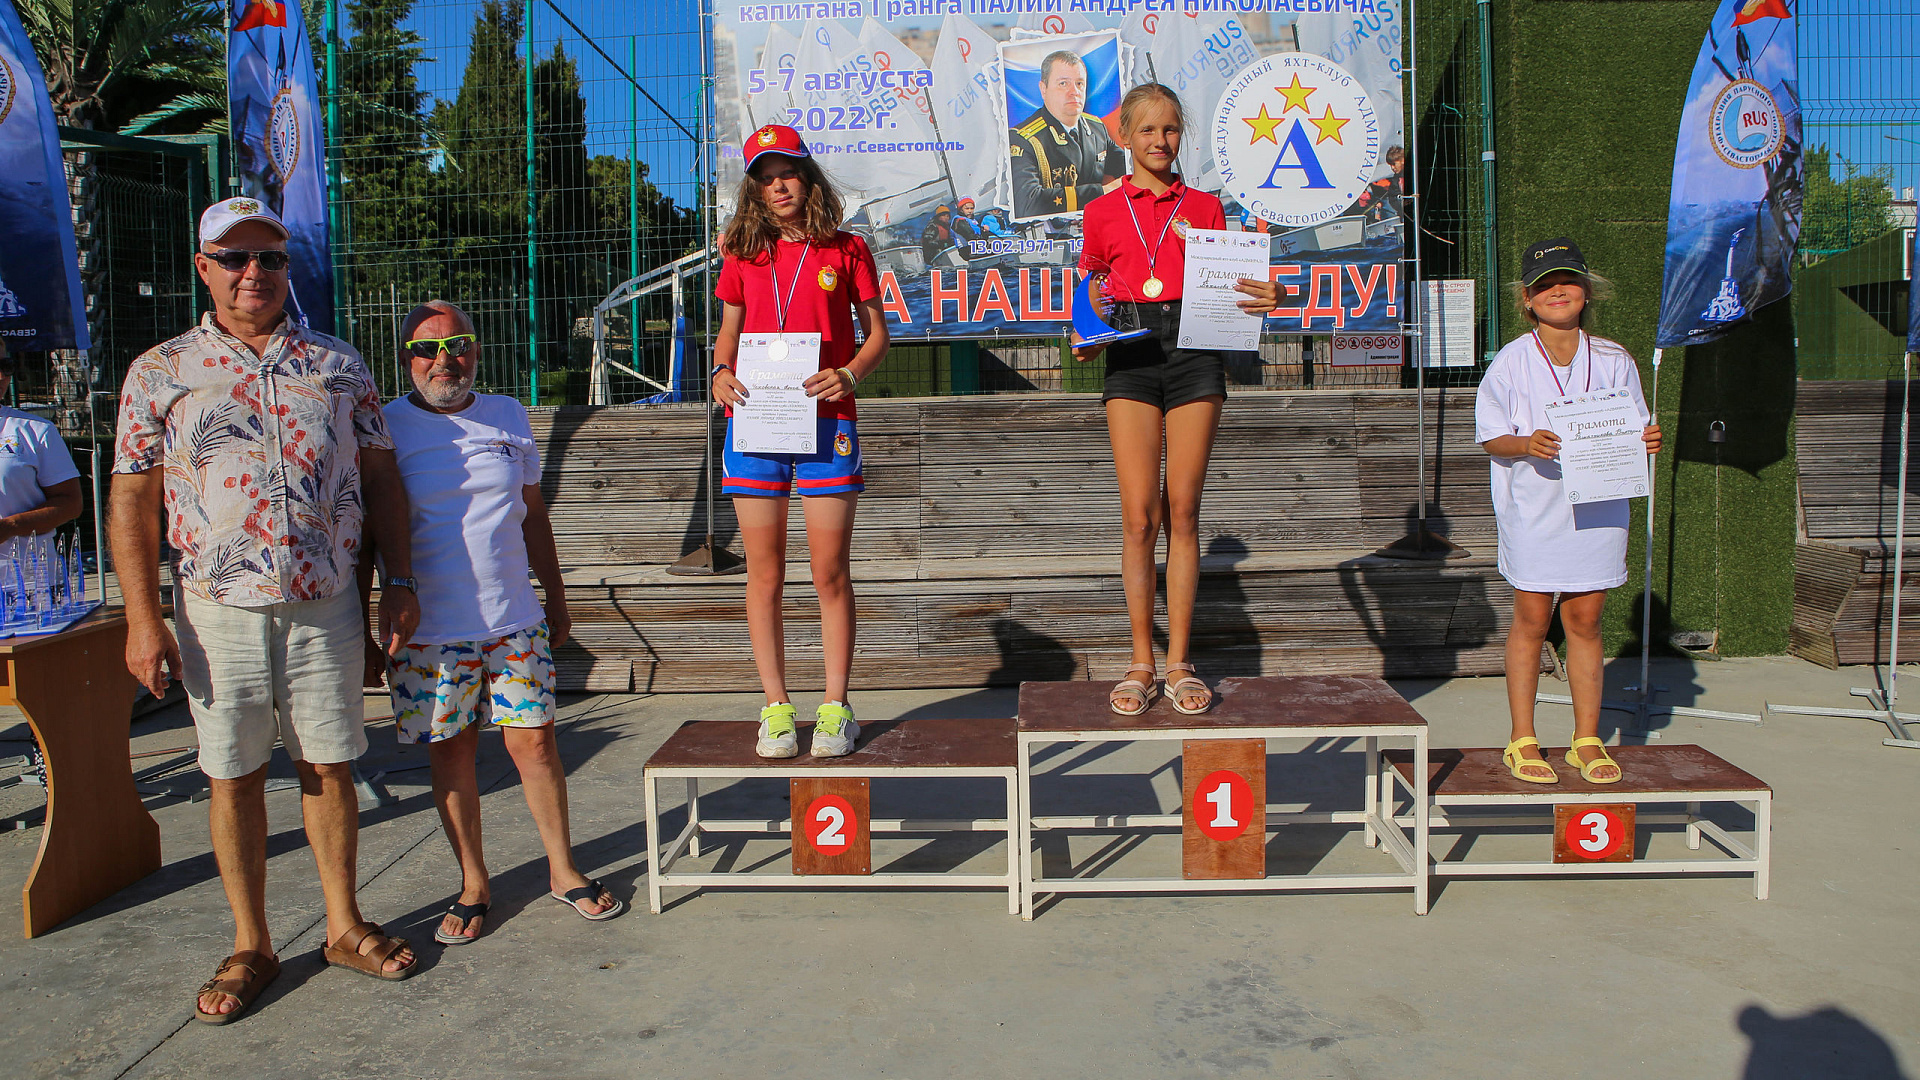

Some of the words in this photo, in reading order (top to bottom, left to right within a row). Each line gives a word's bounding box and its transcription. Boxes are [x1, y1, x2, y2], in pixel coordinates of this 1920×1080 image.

[739, 1, 862, 22] капитана
[887, 0, 963, 22] ранга
[1070, 0, 1175, 16] АНДРЕЯ
[1178, 0, 1377, 14] НИКОЛАЕВИЧА
[1204, 20, 1242, 59] RUS
[748, 67, 796, 95] 5-7
[803, 68, 934, 97] августа
[785, 105, 867, 133] 2022
[875, 109, 897, 129] г.
[1217, 60, 1273, 184] Международный
[1284, 57, 1353, 88] яхт-клуб
[1354, 95, 1378, 184] АДМИРАЛ
[1743, 110, 1768, 128] RUS
[846, 140, 965, 154] г.Севастополь
[1250, 199, 1344, 224] Севастополь
[968, 239, 1054, 255] 13.02.1971
[1199, 267, 1254, 282] Грамота
[931, 267, 1089, 323] НАШ
[1267, 264, 1397, 328] ЕДУ!
[1567, 417, 1626, 433] Грамота
[1207, 783, 1239, 828] 1
[815, 805, 846, 846] 2
[1579, 811, 1609, 852] 3
